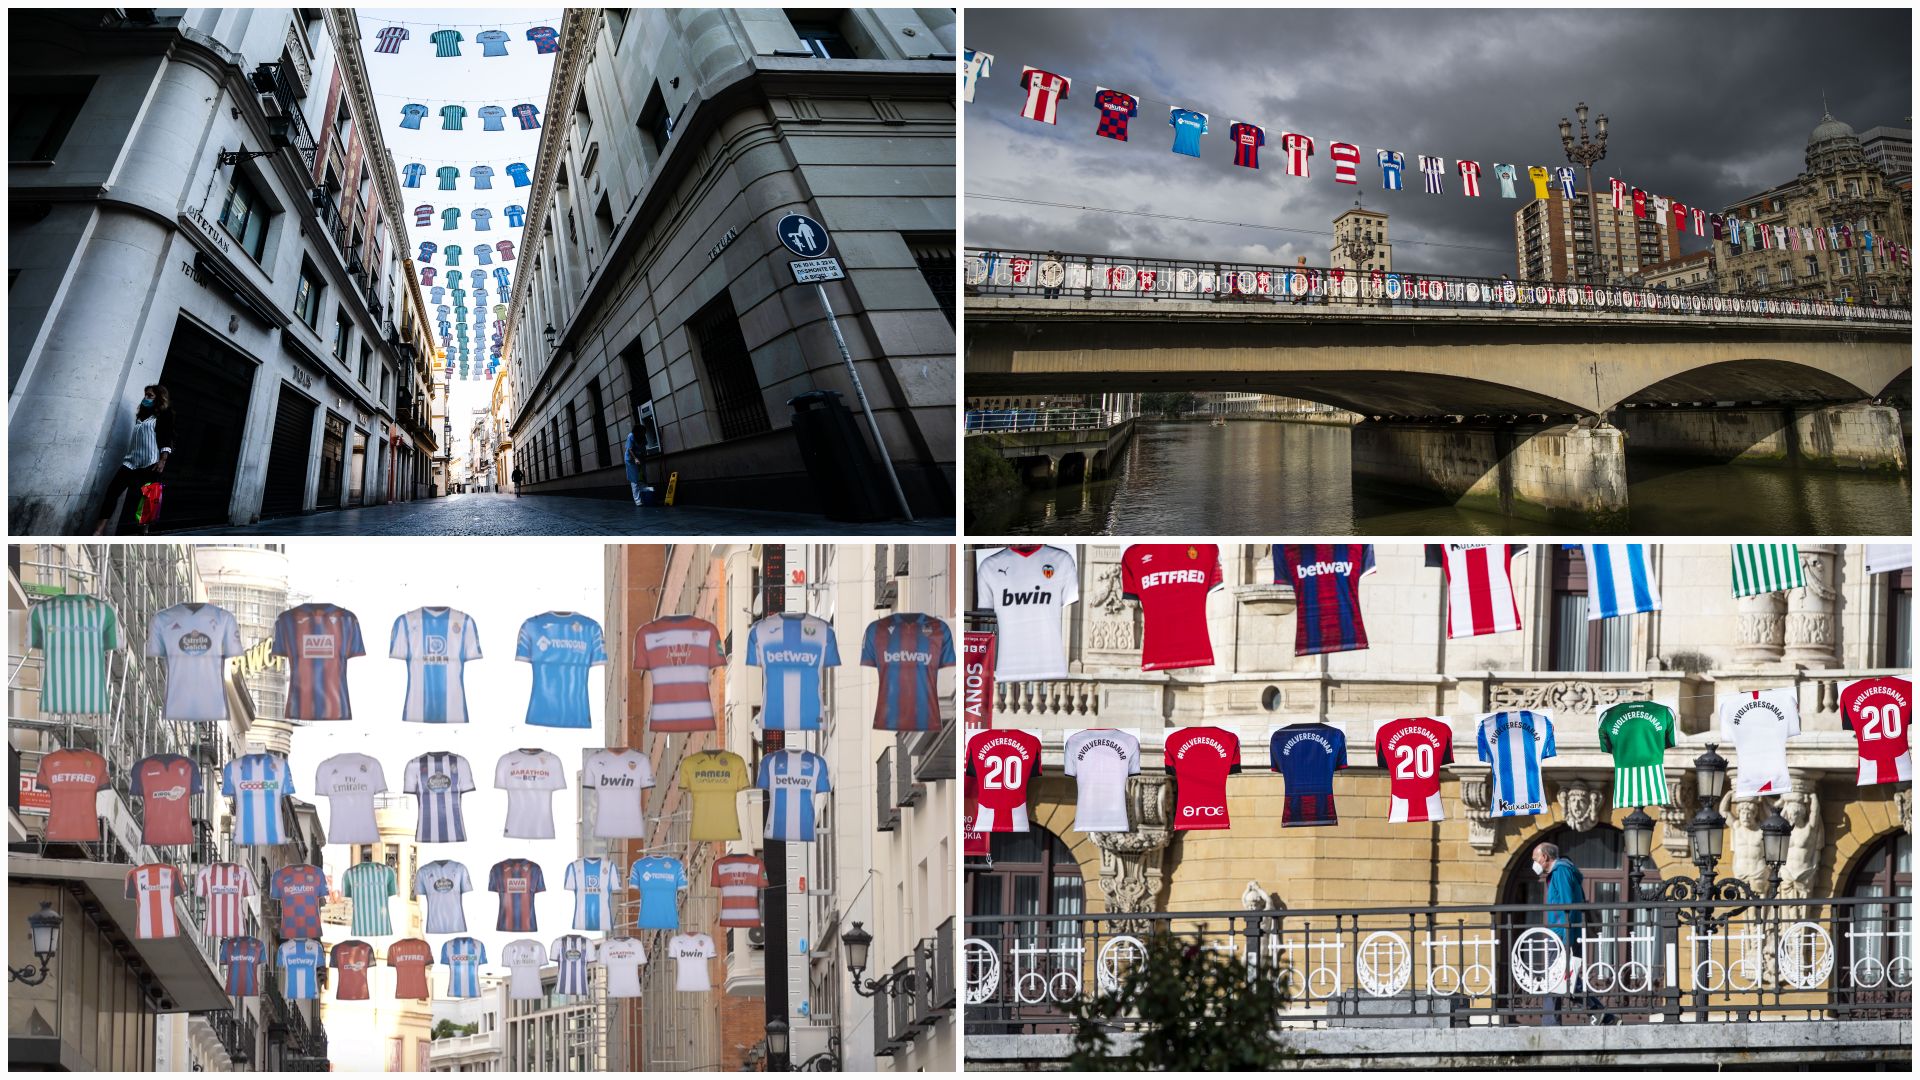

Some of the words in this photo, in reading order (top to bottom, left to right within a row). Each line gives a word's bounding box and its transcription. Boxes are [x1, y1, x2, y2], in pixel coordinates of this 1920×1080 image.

[707, 225, 737, 261] TETUAN
[791, 569, 805, 584] 30
[1297, 561, 1353, 579] betway
[1142, 570, 1205, 589] BETFRED
[1002, 585, 1052, 607] bwin
[182, 636, 209, 644] Estrella
[766, 650, 818, 666] betway
[883, 650, 933, 665] betway
[1853, 686, 1907, 712] #VOLVERESGANAR
[1612, 710, 1662, 735] #VOLVERESGANAR
[1734, 701, 1785, 726] #VOLVERESGANAR
[1860, 703, 1902, 742] 20
[1388, 726, 1441, 751] #VOLVERESGANAR
[1490, 721, 1541, 744] #VOLVERESGANAR
[978, 737, 1030, 761] #VOLVERESGANAR
[1078, 739, 1128, 761] #VOLVERESGANAR
[1177, 737, 1227, 760] #VOLVERESGANAR
[1283, 733, 1333, 756] #VOLVERESGANAR
[1395, 744, 1434, 780] 20
[51, 772, 96, 784] BETFRED
[510, 769, 550, 777] MARATHON
[600, 773, 634, 787] bwin
[694, 770, 731, 778] PAMESA
[775, 776, 812, 787] betway
[984, 755, 1022, 790] 20
[239, 781, 279, 791] GoodBall
[1498, 798, 1543, 812] Kutxabank
[230, 954, 255, 963] betway
[287, 957, 314, 966] betway
[680, 949, 703, 958] bwin
